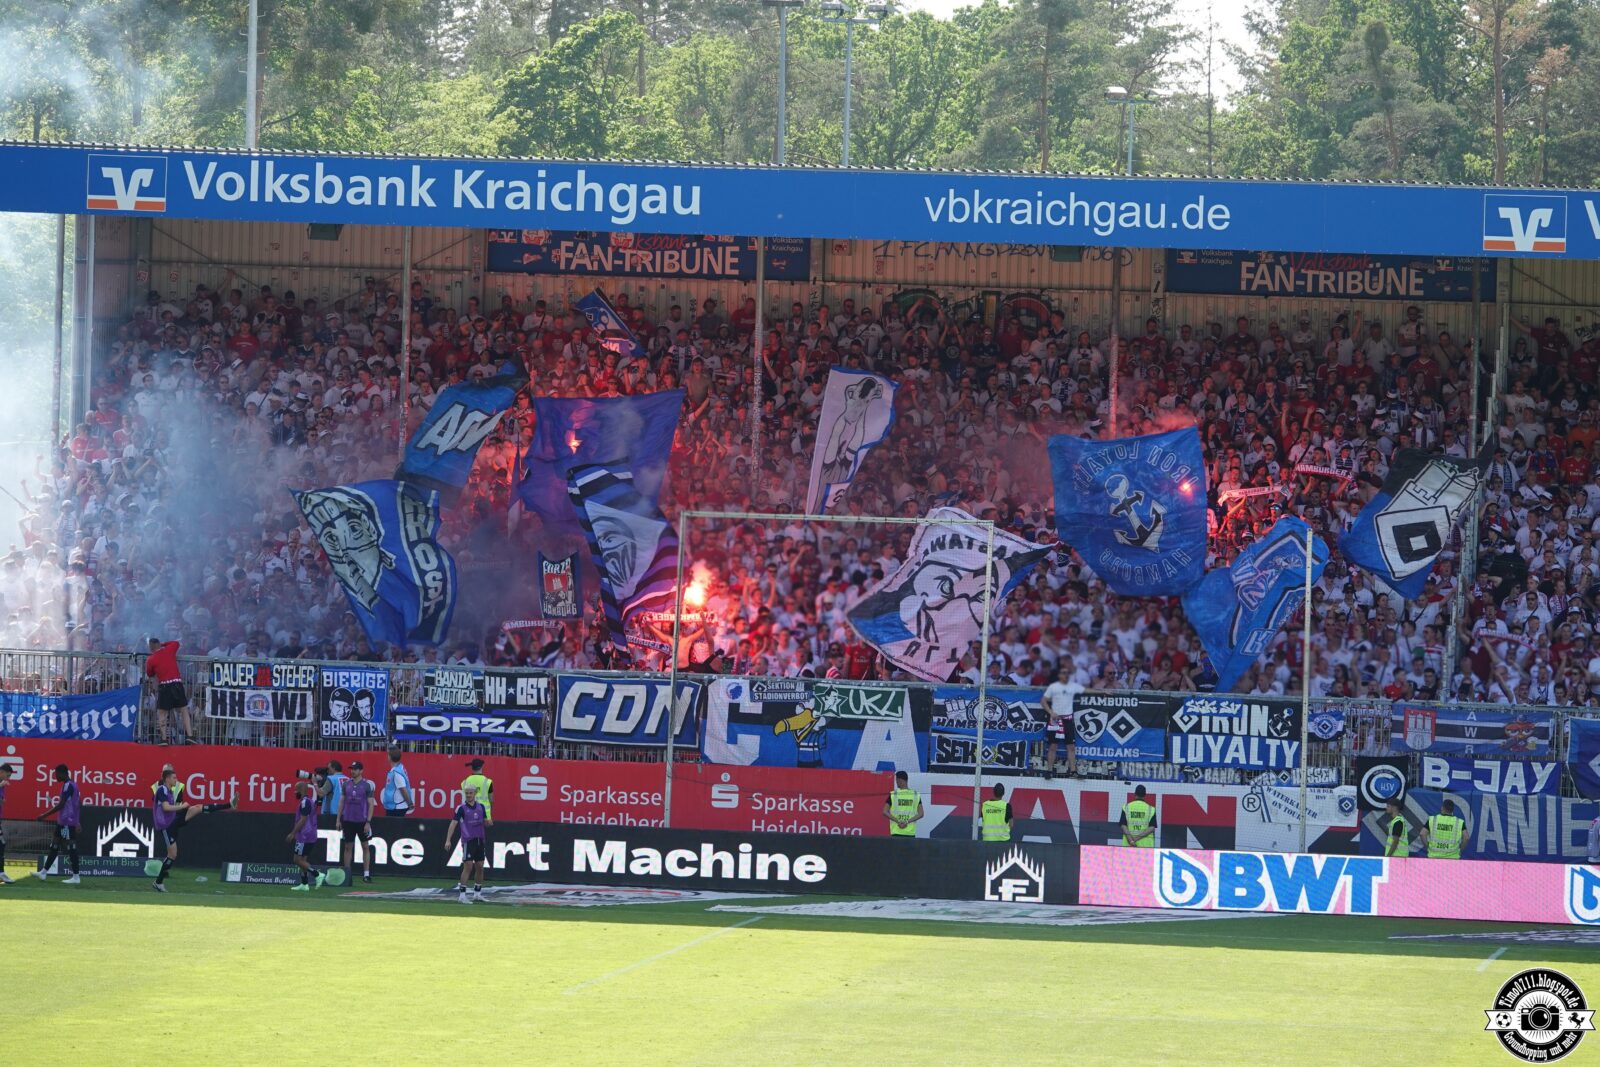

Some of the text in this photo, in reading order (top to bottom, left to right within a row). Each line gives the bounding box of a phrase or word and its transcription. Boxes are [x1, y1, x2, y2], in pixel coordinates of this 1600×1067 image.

[183, 160, 700, 224] Volksbank Kraichgau
[925, 188, 1231, 236] vbkraichgau.de
[559, 240, 740, 276] FAN-TRIBÜNE
[1240, 261, 1424, 297] FAN-TRIBÜNE
[213, 663, 315, 688] DAUER STEHER
[322, 671, 387, 689] BIERIGE
[434, 671, 474, 689] BANDA
[767, 681, 796, 691] SEKTION
[428, 686, 477, 706] CAOTICA
[485, 675, 507, 705] HH
[754, 692, 809, 701] STADIONVERBOT
[1079, 696, 1139, 708] HAMBURG
[560, 681, 694, 735] CDN
[321, 720, 387, 737] BANDITEN
[395, 715, 535, 737] FORZA
[1172, 733, 1300, 769] LOYALTY
[1423, 756, 1557, 794] B-JAY
[186, 773, 239, 801] Gut
[249, 774, 292, 803] für
[559, 785, 663, 809] Sparkasse
[751, 792, 854, 816] Sparkasse
[103, 857, 118, 867] mit
[121, 857, 140, 867] Biss
[246, 863, 282, 874] Küchen
[285, 865, 300, 874] mit
[573, 838, 828, 883] Machine
[246, 876, 273, 884] Thomas
[1218, 852, 1384, 913] BWT
